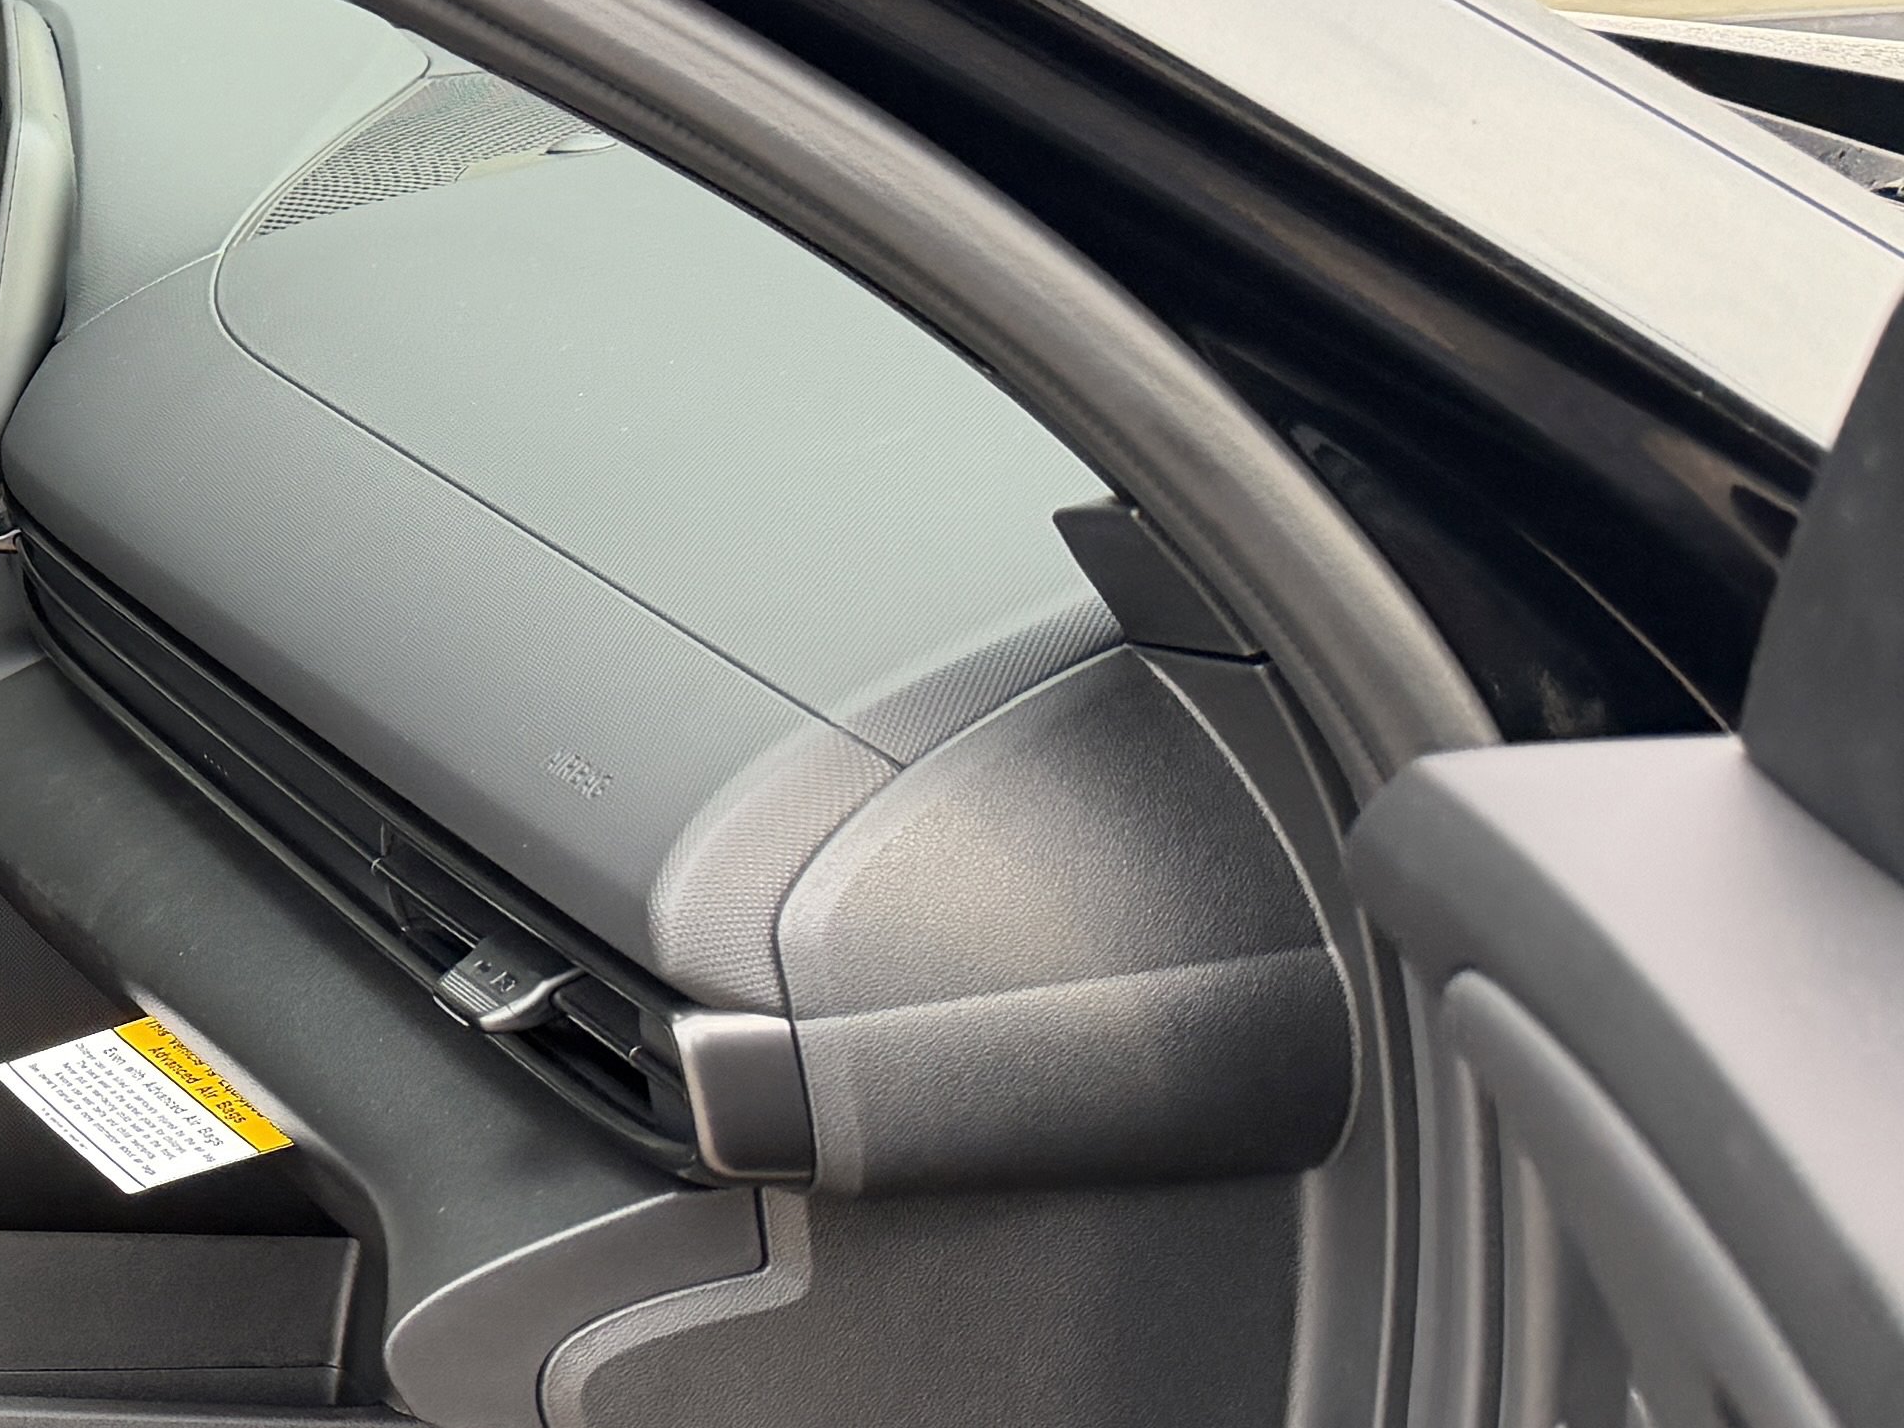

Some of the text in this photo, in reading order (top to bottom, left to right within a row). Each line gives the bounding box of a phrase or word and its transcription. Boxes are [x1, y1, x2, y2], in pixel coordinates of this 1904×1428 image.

[148, 1046, 247, 1124] Advanced Air Bags
